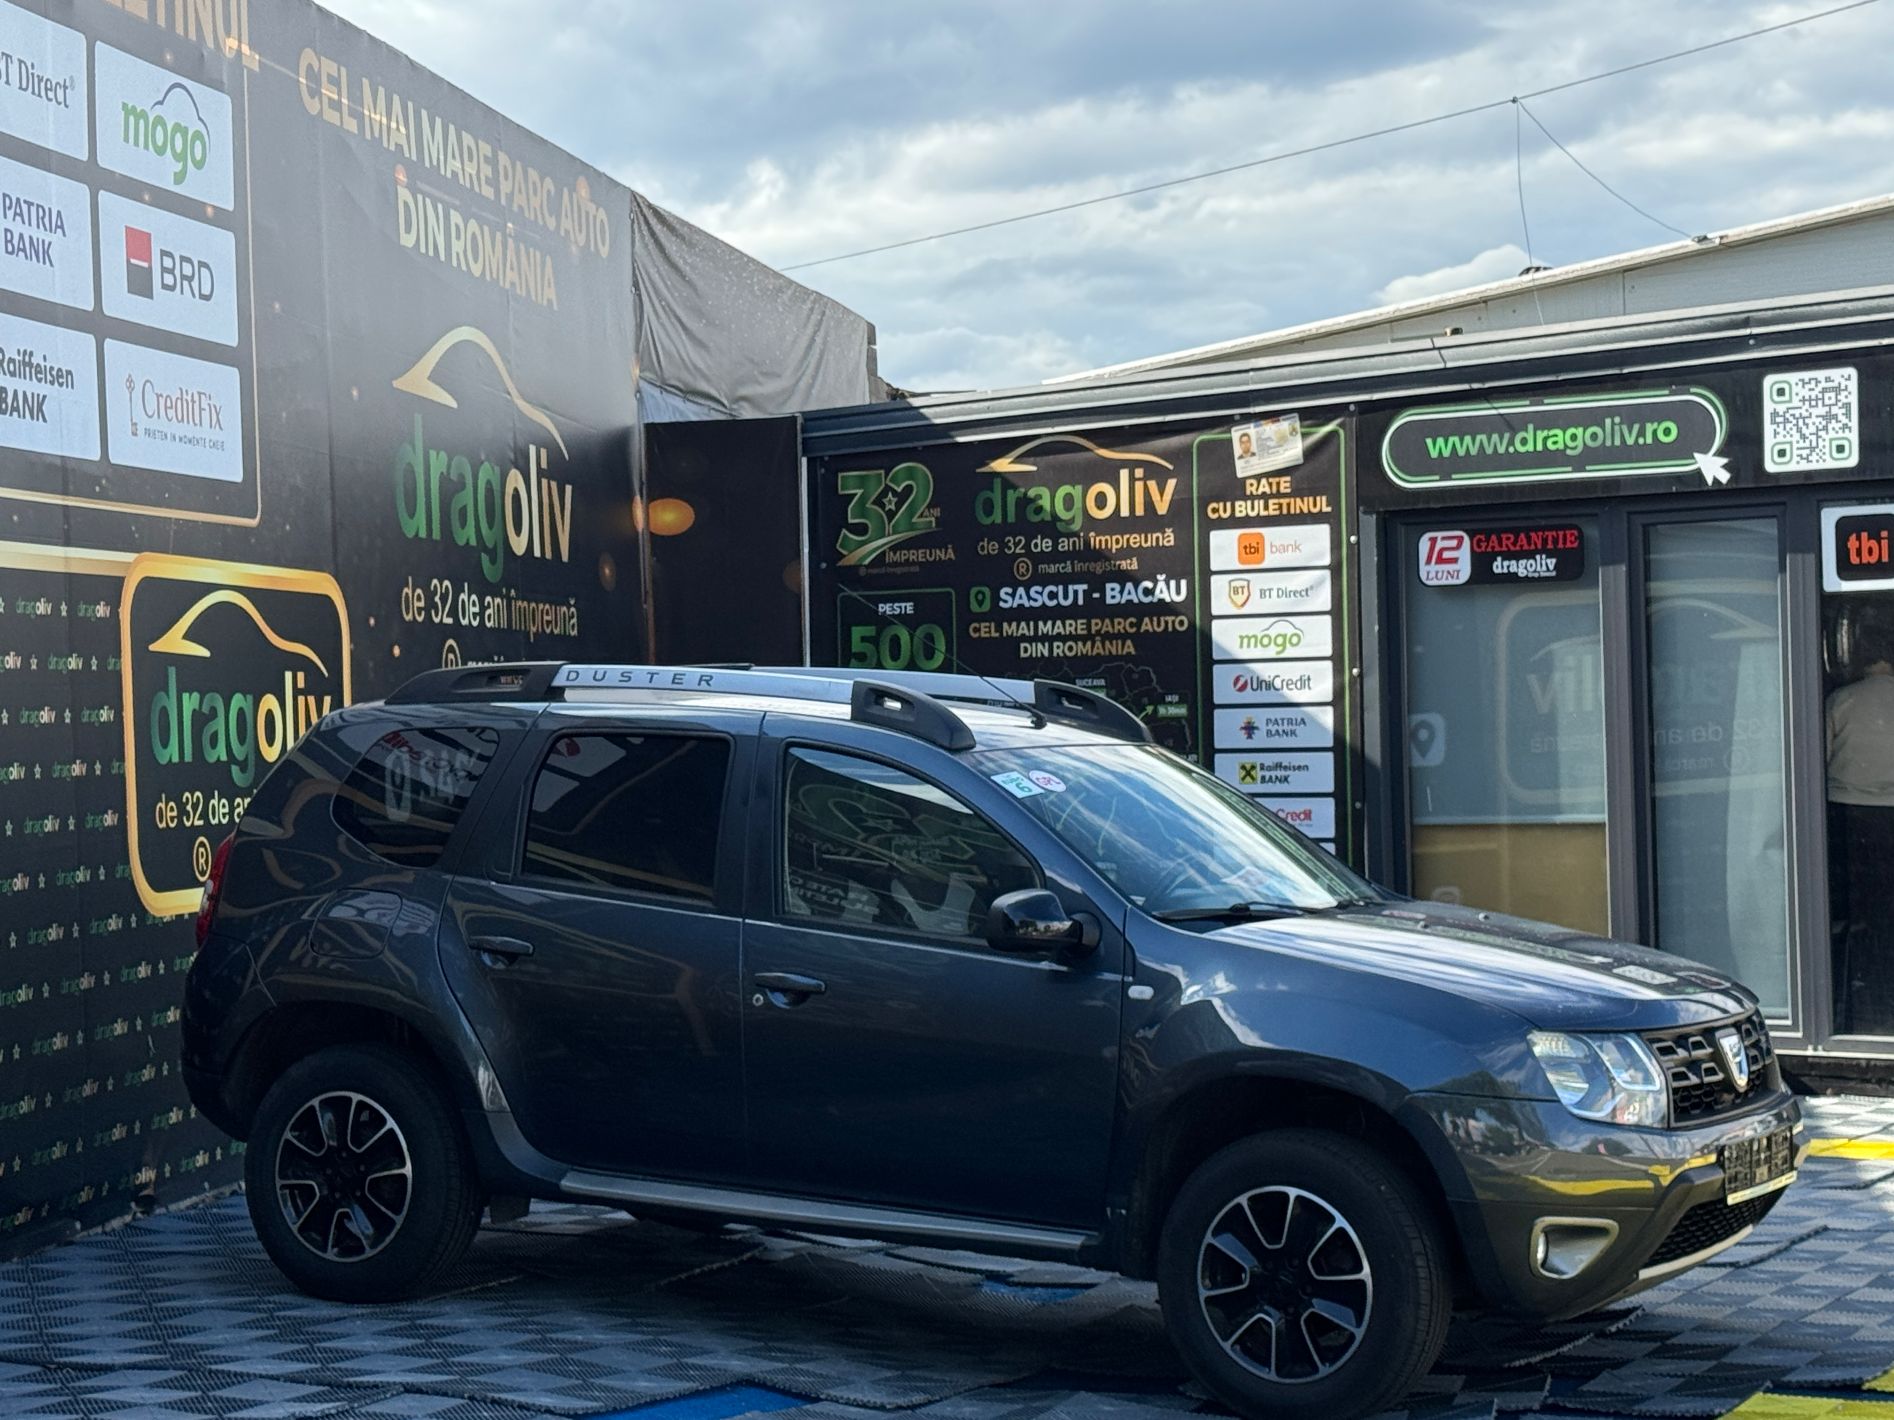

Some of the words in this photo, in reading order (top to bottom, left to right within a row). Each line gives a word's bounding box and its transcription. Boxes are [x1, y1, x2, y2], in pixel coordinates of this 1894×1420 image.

[0, 51, 13, 86] T
[121, 101, 207, 186] mogo
[299, 47, 358, 135] CEL
[362, 77, 417, 161] MAI
[421, 108, 494, 200] MARE
[498, 150, 556, 231] PARC
[560, 187, 610, 259] AUTO
[2, 193, 67, 238] PATRIA
[4, 227, 54, 268] BANK
[397, 185, 445, 262] DIN
[450, 208, 558, 311] ROMÂNIA
[159, 248, 215, 302] BRD
[0, 385, 48, 424] BANK
[141, 379, 224, 432] CreditFix
[1426, 417, 1678, 458] www.dragoliv.ro
[395, 413, 573, 583] dragoliv
[1245, 476, 1292, 496] RATE
[836, 462, 936, 555] 32
[975, 468, 1178, 533] dragoliv
[1207, 501, 1231, 519] CU
[1234, 495, 1332, 518] BULETINUL
[885, 544, 956, 564] ÎMPREUNĂ
[977, 538, 999, 555] de
[1004, 536, 1026, 554] 32
[1030, 534, 1052, 553] de
[1058, 532, 1084, 551] ani
[1088, 528, 1175, 554] împreună
[1242, 541, 1260, 556] tbi
[1270, 540, 1302, 555] bank
[1424, 535, 1464, 566] 12
[1472, 530, 1579, 553] GARANTIE
[1847, 530, 1889, 565] tbi
[1038, 559, 1073, 574] marcă
[1425, 569, 1461, 581] LUNI
[1492, 554, 1557, 577] dragoliv
[998, 584, 1088, 609] SASCUT
[1104, 574, 1188, 605] BACĂU
[1232, 586, 1246, 596] BT
[1259, 588, 1274, 600] BT
[402, 576, 425, 622] de
[430, 578, 453, 625] 32
[458, 582, 480, 627] de
[484, 587, 507, 630] ani
[509, 588, 578, 643] împreună
[878, 602, 914, 615] PESTE
[969, 622, 1000, 639] CEL
[1003, 621, 1034, 637] MAI
[1037, 618, 1088, 637] MARE
[1091, 617, 1137, 635] PARC
[1140, 615, 1188, 633] AUTO
[850, 623, 946, 671] 500
[1020, 642, 1050, 659] DIN
[1053, 637, 1136, 657] ROMÂNIA
[1238, 632, 1302, 656] mogo
[565, 669, 715, 687] DUSTER
[1250, 674, 1312, 692] UniCredit
[1265, 717, 1307, 728] PATRIA
[1265, 729, 1298, 739] BANK
[1259, 762, 1309, 773] Raiffeisen
[1260, 774, 1291, 785] BANK
[155, 792, 178, 829] de
[182, 790, 204, 827] 32
[208, 789, 229, 825] de
